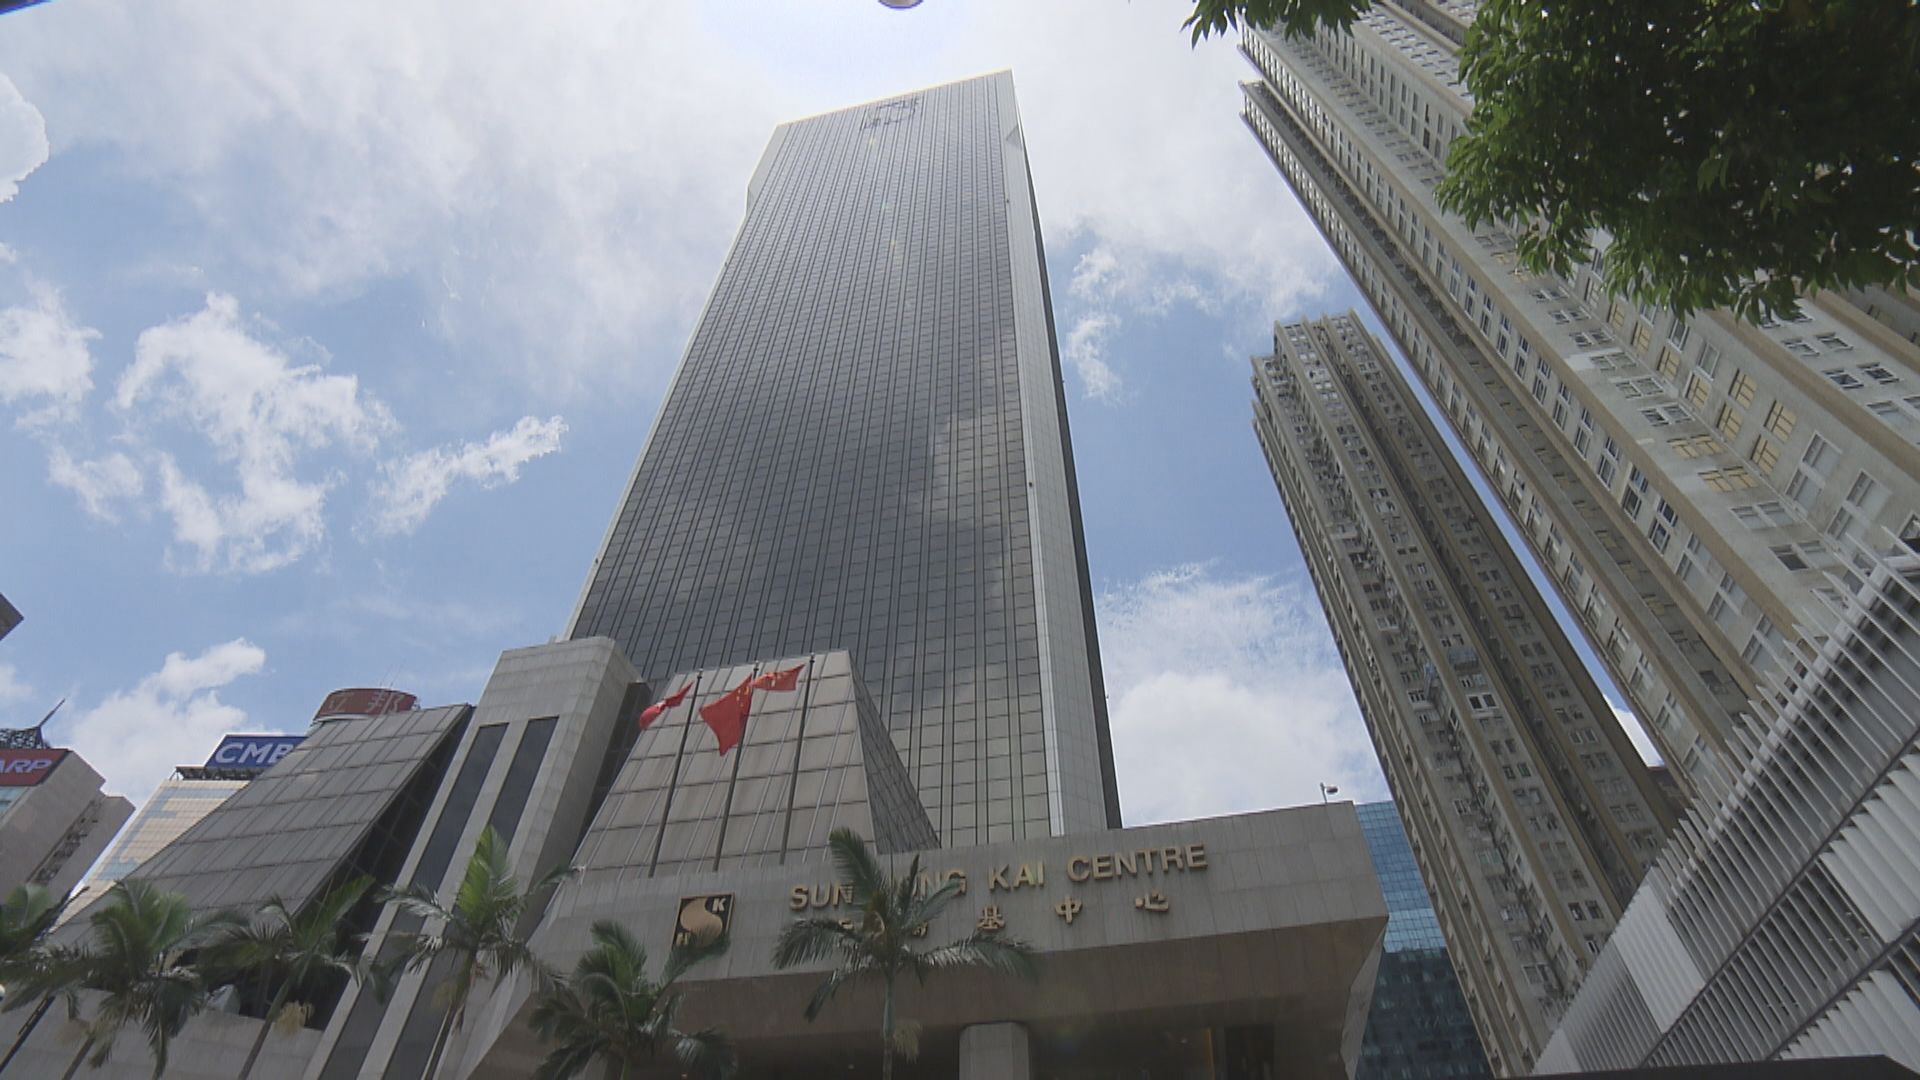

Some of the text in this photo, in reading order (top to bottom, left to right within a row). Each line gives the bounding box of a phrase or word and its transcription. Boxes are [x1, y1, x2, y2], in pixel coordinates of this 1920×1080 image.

[789, 879, 855, 911] SUN
[988, 861, 1046, 892] KAI
[1067, 843, 1209, 883] CENTRE
